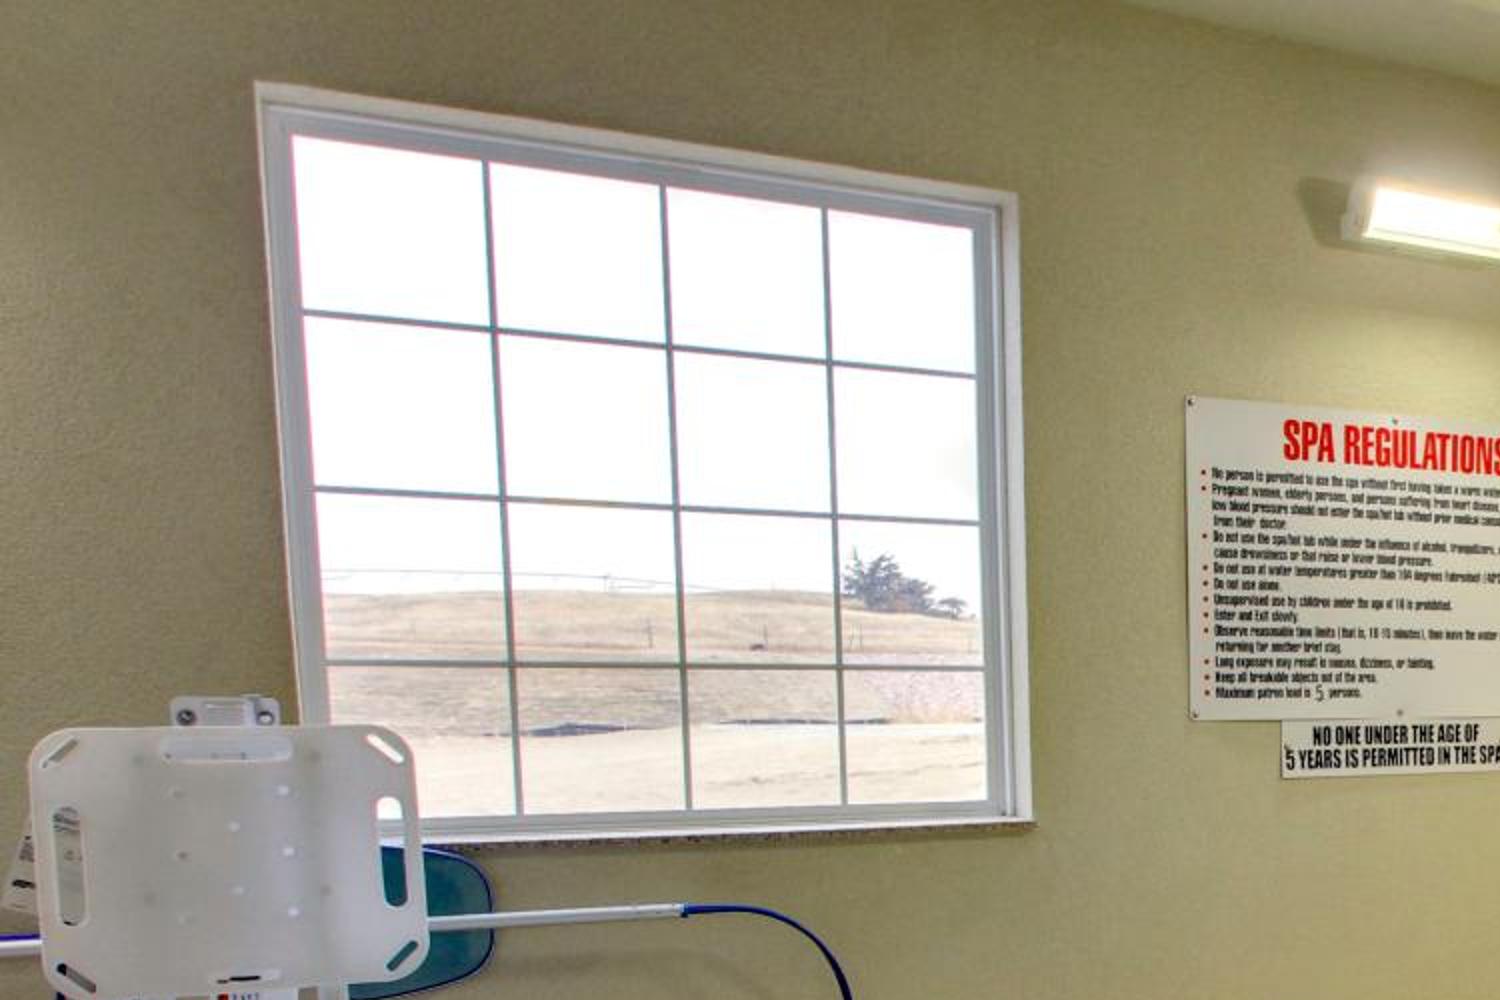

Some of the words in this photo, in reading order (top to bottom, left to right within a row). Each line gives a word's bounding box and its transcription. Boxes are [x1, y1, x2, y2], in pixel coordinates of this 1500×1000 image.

[1283, 419, 1335, 463] SPA
[1314, 684, 1325, 701] 5
[1312, 726, 1331, 746] NO
[1335, 726, 1361, 744] ONE
[1364, 725, 1409, 744] UNDER
[1412, 724, 1434, 743] THE
[1437, 724, 1461, 743] AGE
[1464, 723, 1480, 742] OF
[1285, 751, 1296, 770] 5
[1299, 748, 1341, 769] YEARS
[1345, 749, 1359, 768] IS
[1362, 747, 1435, 768] PERMITTED
[1438, 746, 1451, 765] IN
[1454, 746, 1476, 764] THE
